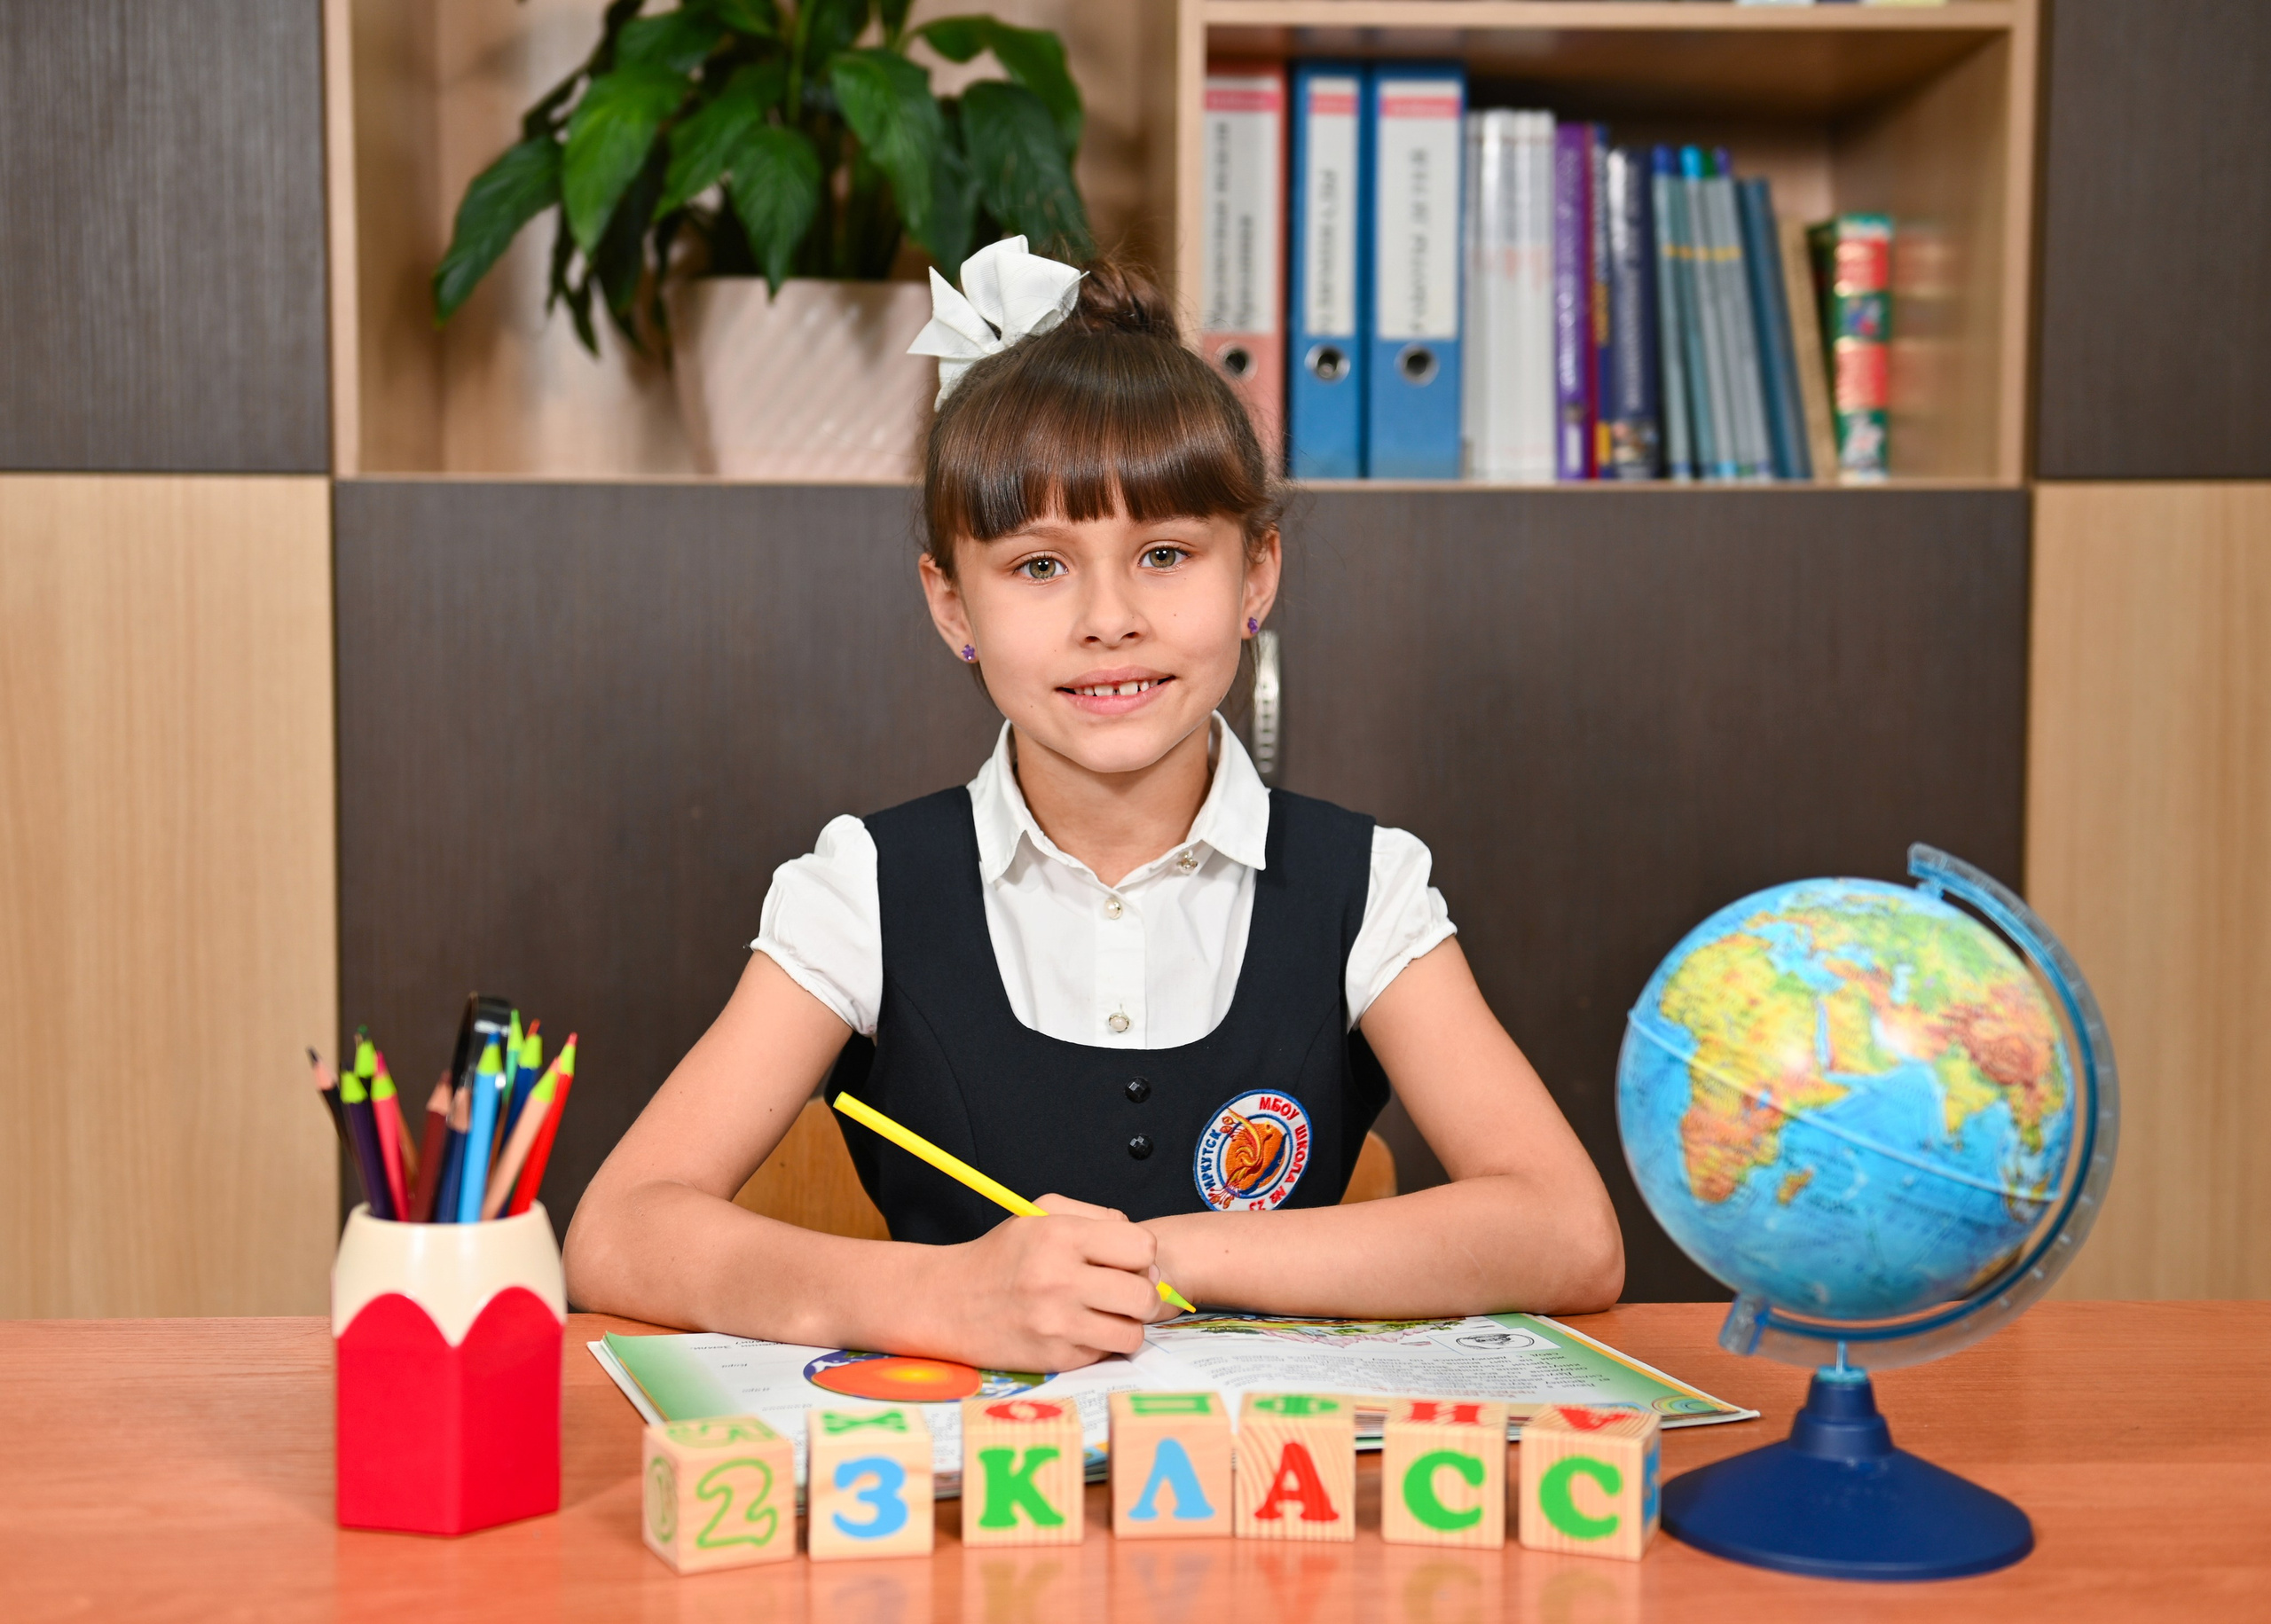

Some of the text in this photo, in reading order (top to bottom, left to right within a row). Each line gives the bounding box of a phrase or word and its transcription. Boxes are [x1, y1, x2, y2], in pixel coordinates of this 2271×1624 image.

[1200, 1128, 1222, 1190] ИРКУТСК
[1259, 1096, 1300, 1121] МБОУ
[1285, 1124, 1309, 1183] ШКОЛА
[695, 1456, 779, 1549] 2
